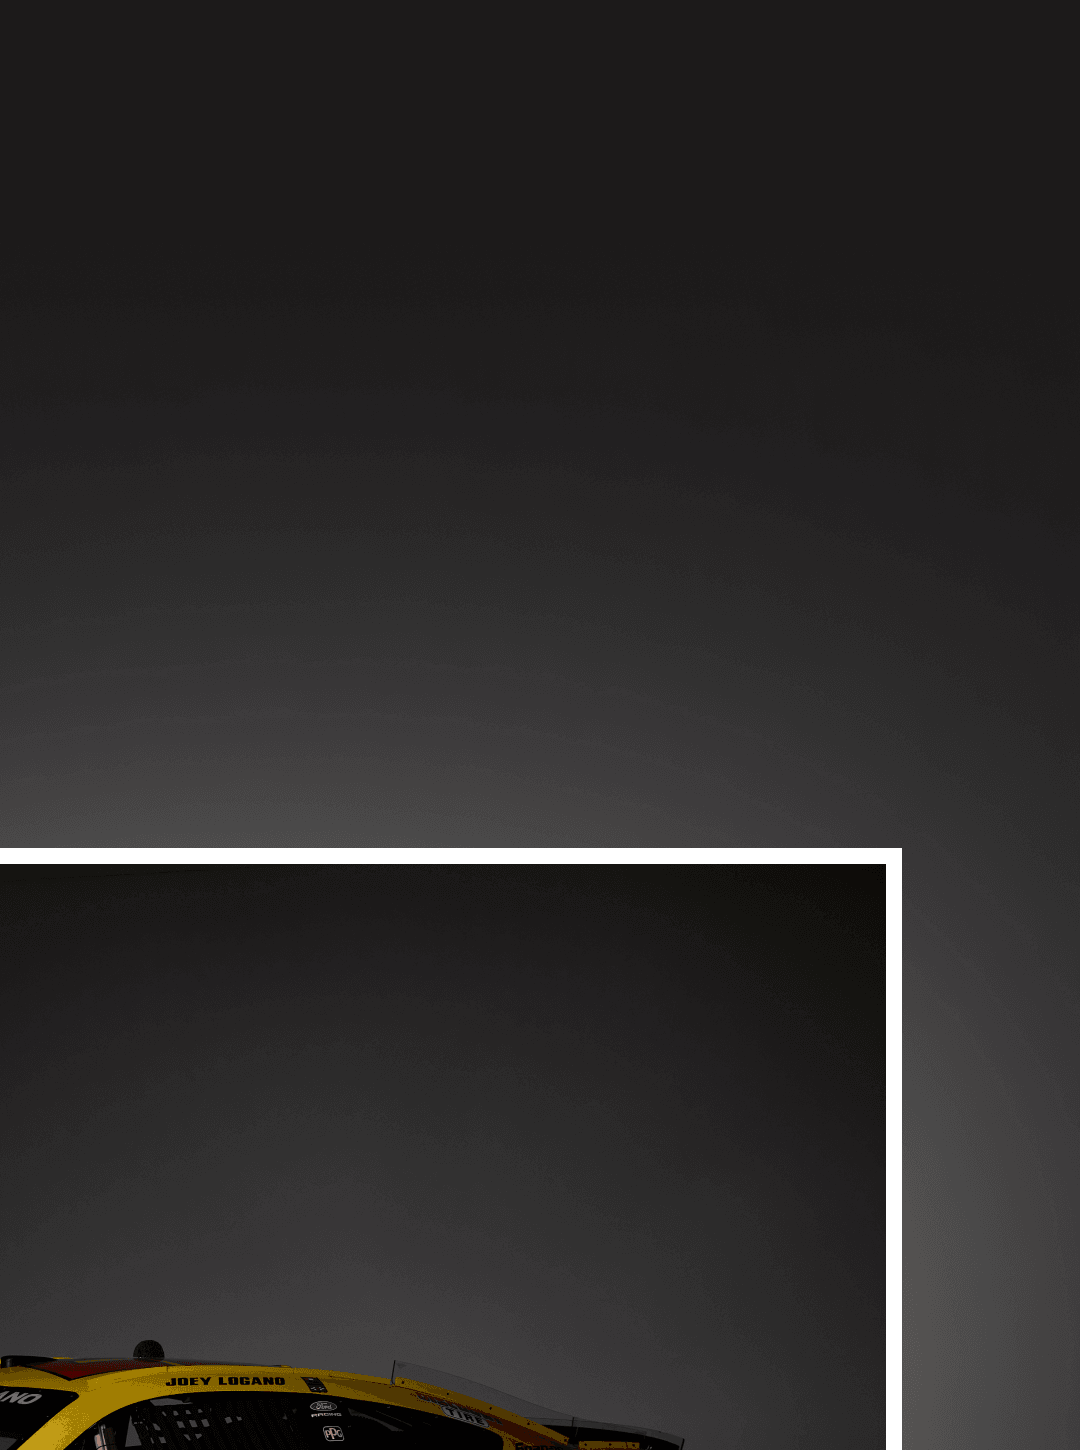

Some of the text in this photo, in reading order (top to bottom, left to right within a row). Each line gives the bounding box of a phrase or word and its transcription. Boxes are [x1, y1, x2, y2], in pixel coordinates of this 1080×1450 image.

[166, 1377, 285, 1386] JOEY LOGANO
[446, 1408, 485, 1425] TIRE
[324, 1427, 343, 1440] PPG
